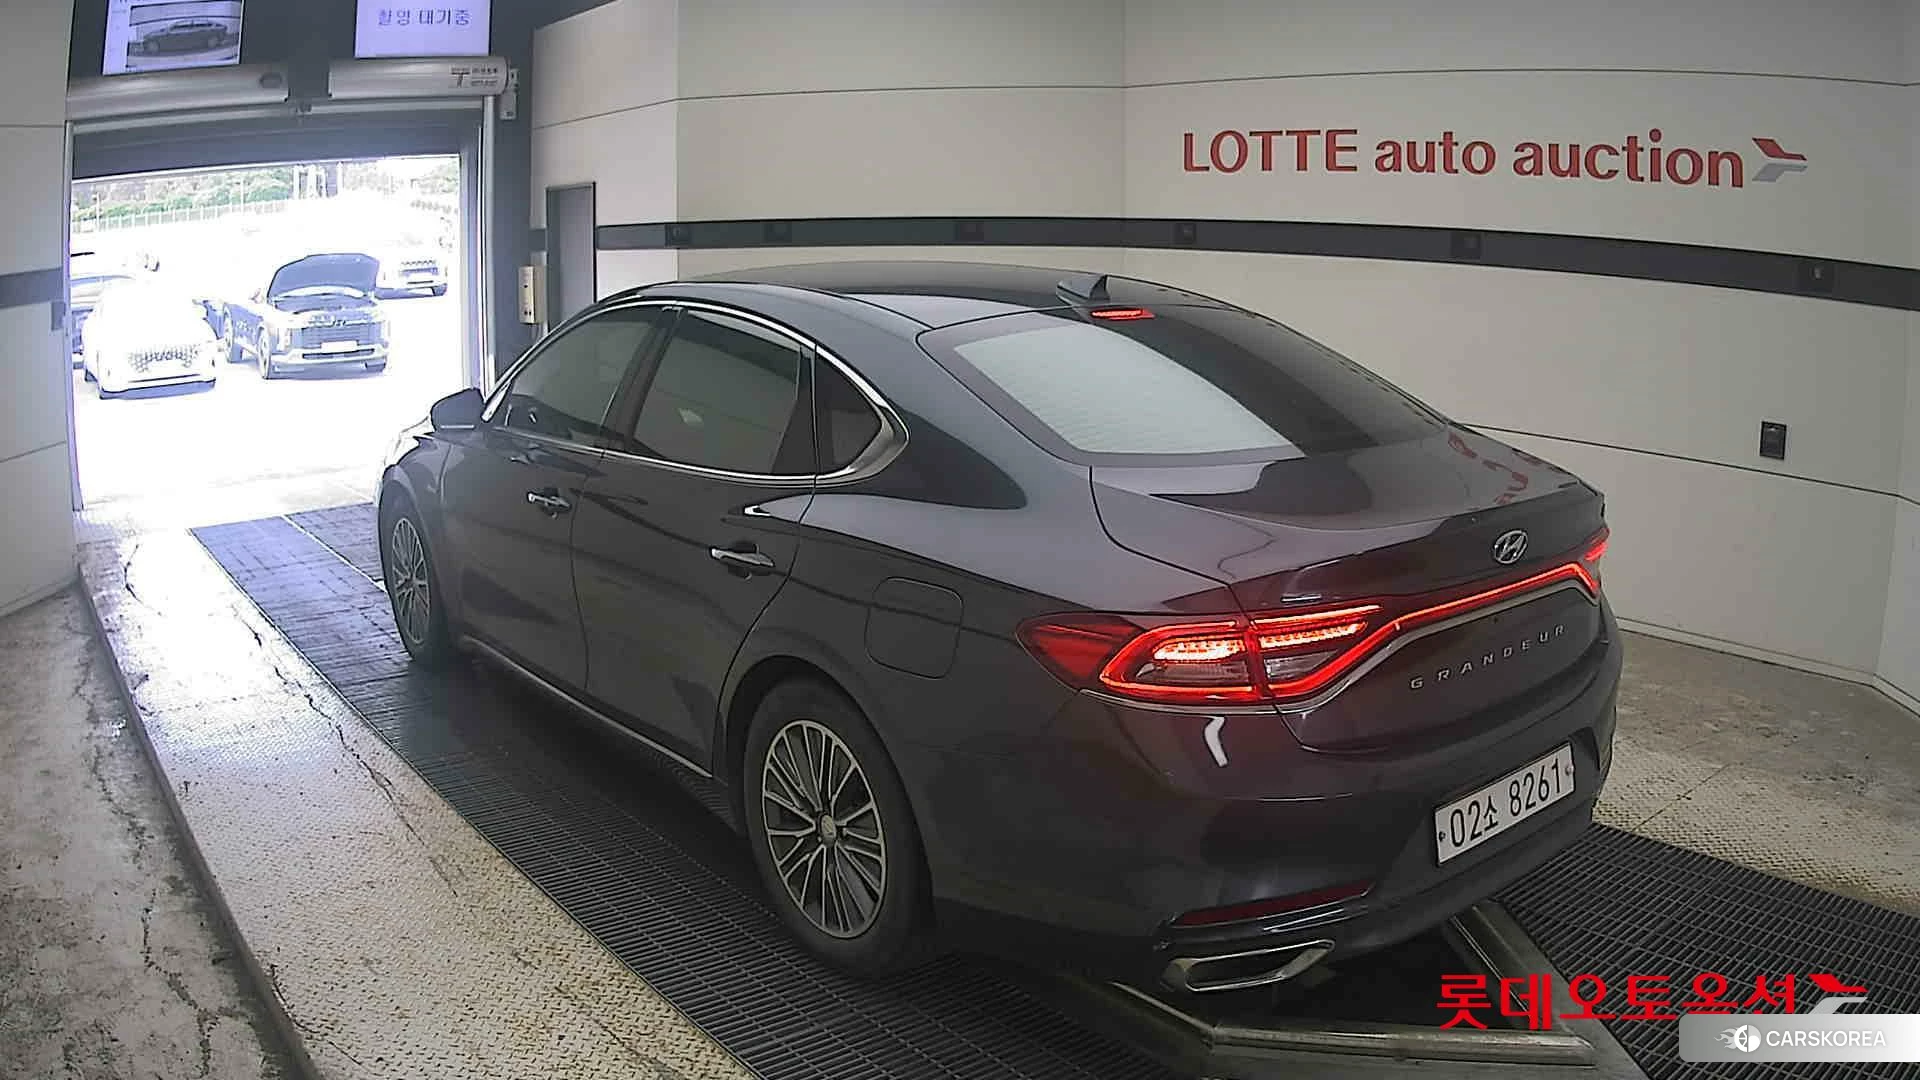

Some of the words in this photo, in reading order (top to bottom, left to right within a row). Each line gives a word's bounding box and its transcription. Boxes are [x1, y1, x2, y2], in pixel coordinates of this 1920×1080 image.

[419, 8, 470, 26] 대기중
[1183, 129, 1358, 173] LOTTE
[1375, 131, 1497, 176] auto
[1512, 128, 1745, 188] auction
[1410, 624, 1565, 690] GRANDEUR
[1450, 795, 1499, 848] 02소
[1509, 758, 1561, 817] 8261
